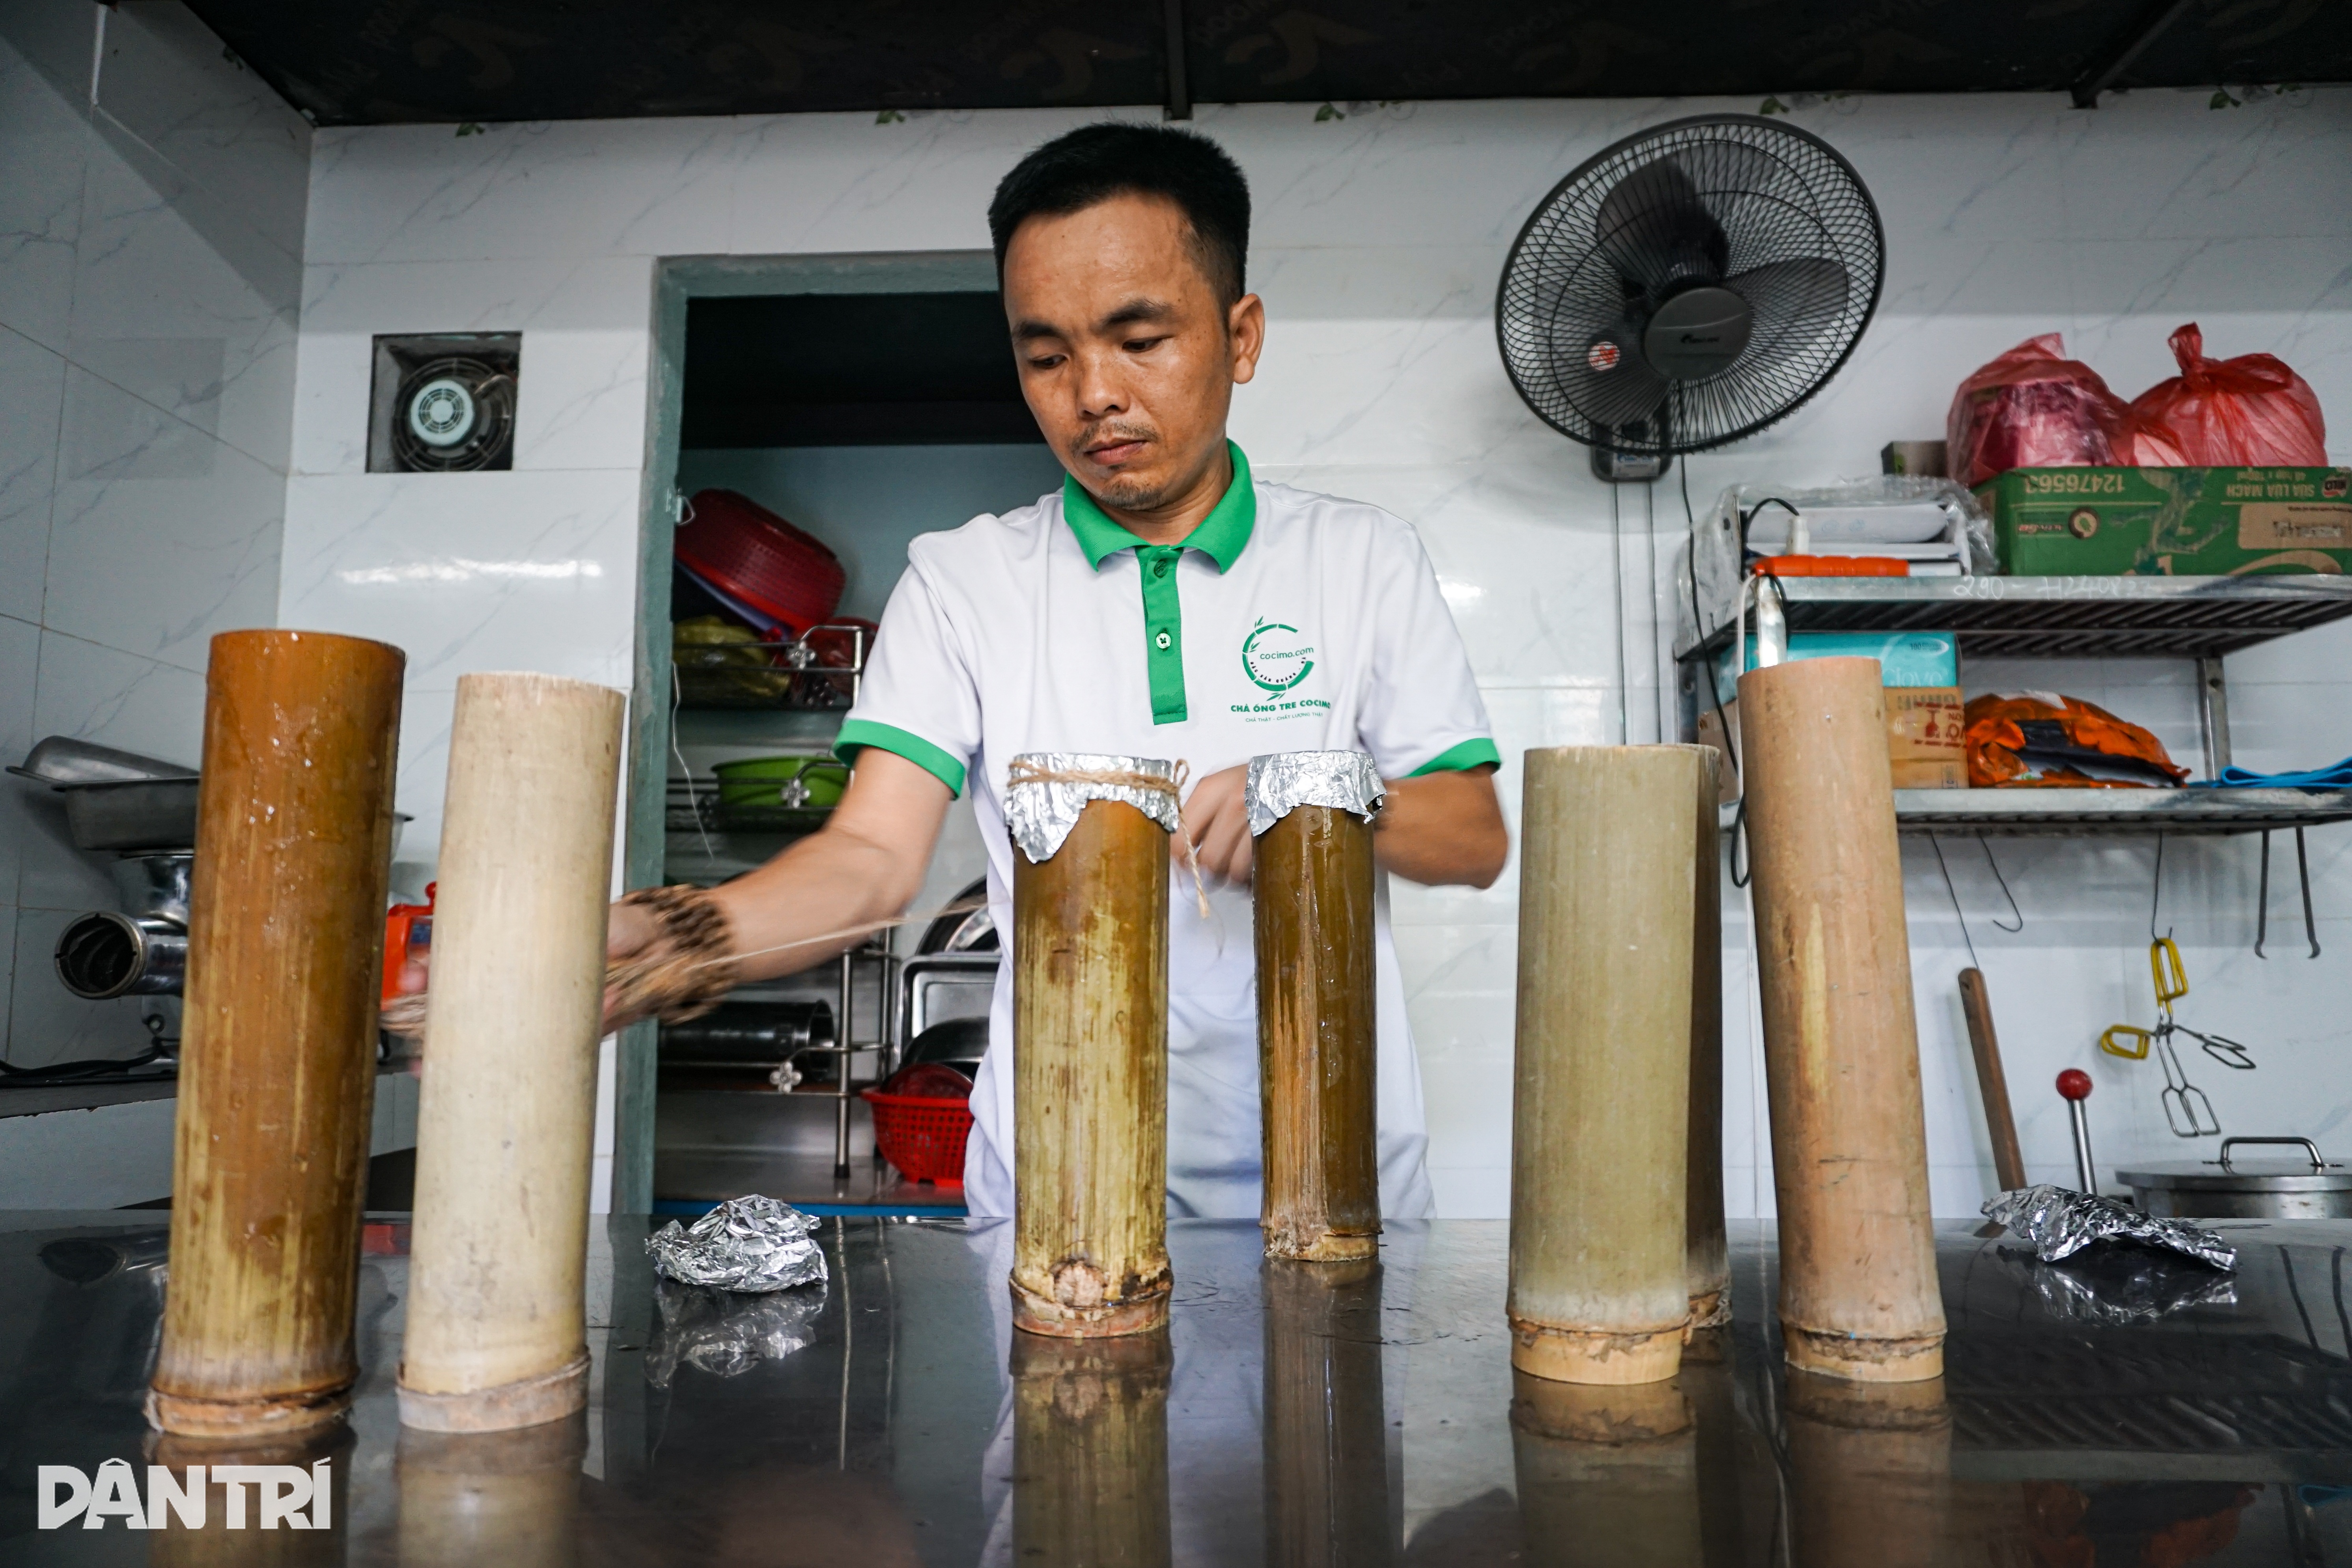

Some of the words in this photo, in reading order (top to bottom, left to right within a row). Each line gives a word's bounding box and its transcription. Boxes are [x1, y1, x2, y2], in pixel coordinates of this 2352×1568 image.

[2025, 474, 2125, 493] 12476563
[1954, 575, 2003, 599] 290
[1260, 647, 1314, 659] cocimo.com
[1253, 703, 1276, 712] ỐNG
[1279, 702, 1296, 710] TRE
[1300, 700, 1331, 709] COCIMO
